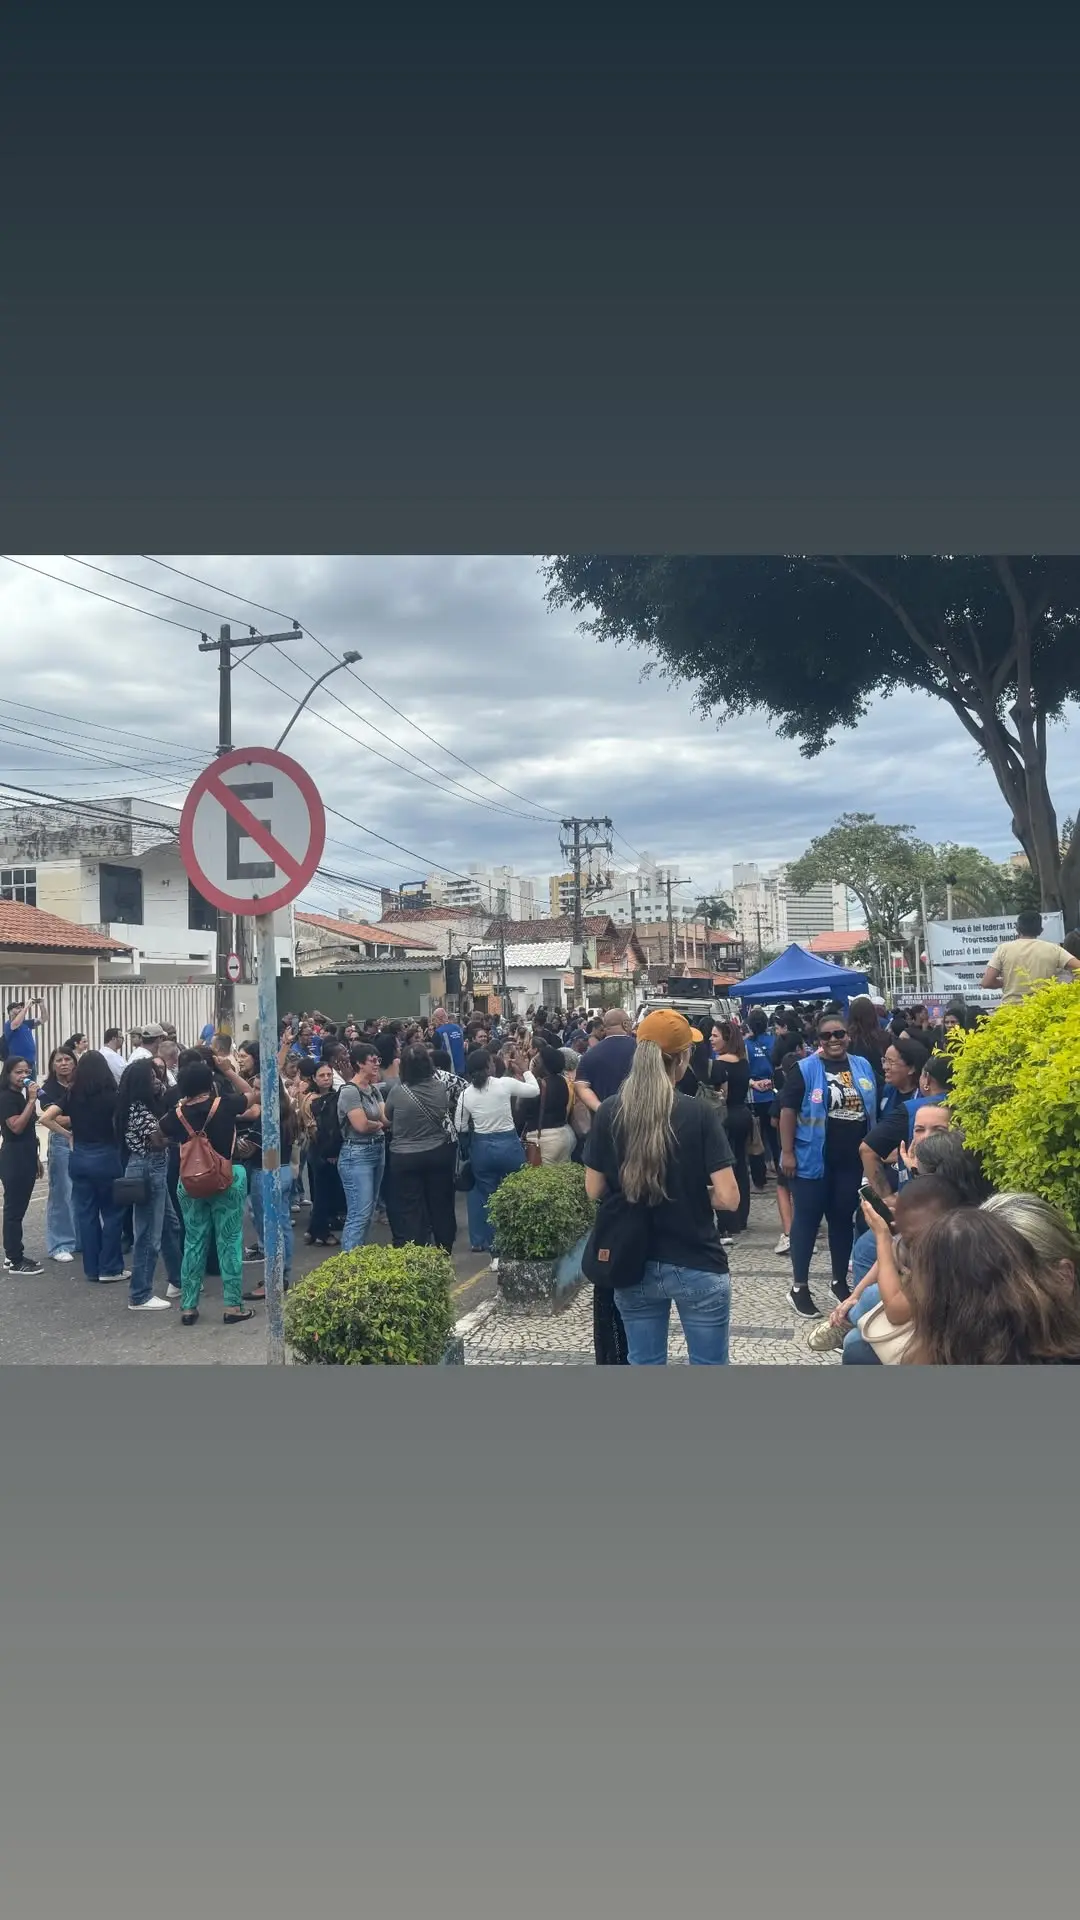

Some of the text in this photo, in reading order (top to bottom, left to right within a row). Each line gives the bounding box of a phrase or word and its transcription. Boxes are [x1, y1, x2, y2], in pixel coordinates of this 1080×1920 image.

[226, 782, 275, 880] E
[967, 924, 972, 932] é
[973, 923, 981, 931] lei
[982, 922, 1005, 931] federal
[962, 935, 998, 944] Progressão
[942, 948, 965, 957] (letras)
[966, 947, 971, 955] é
[972, 946, 980, 954] lei
